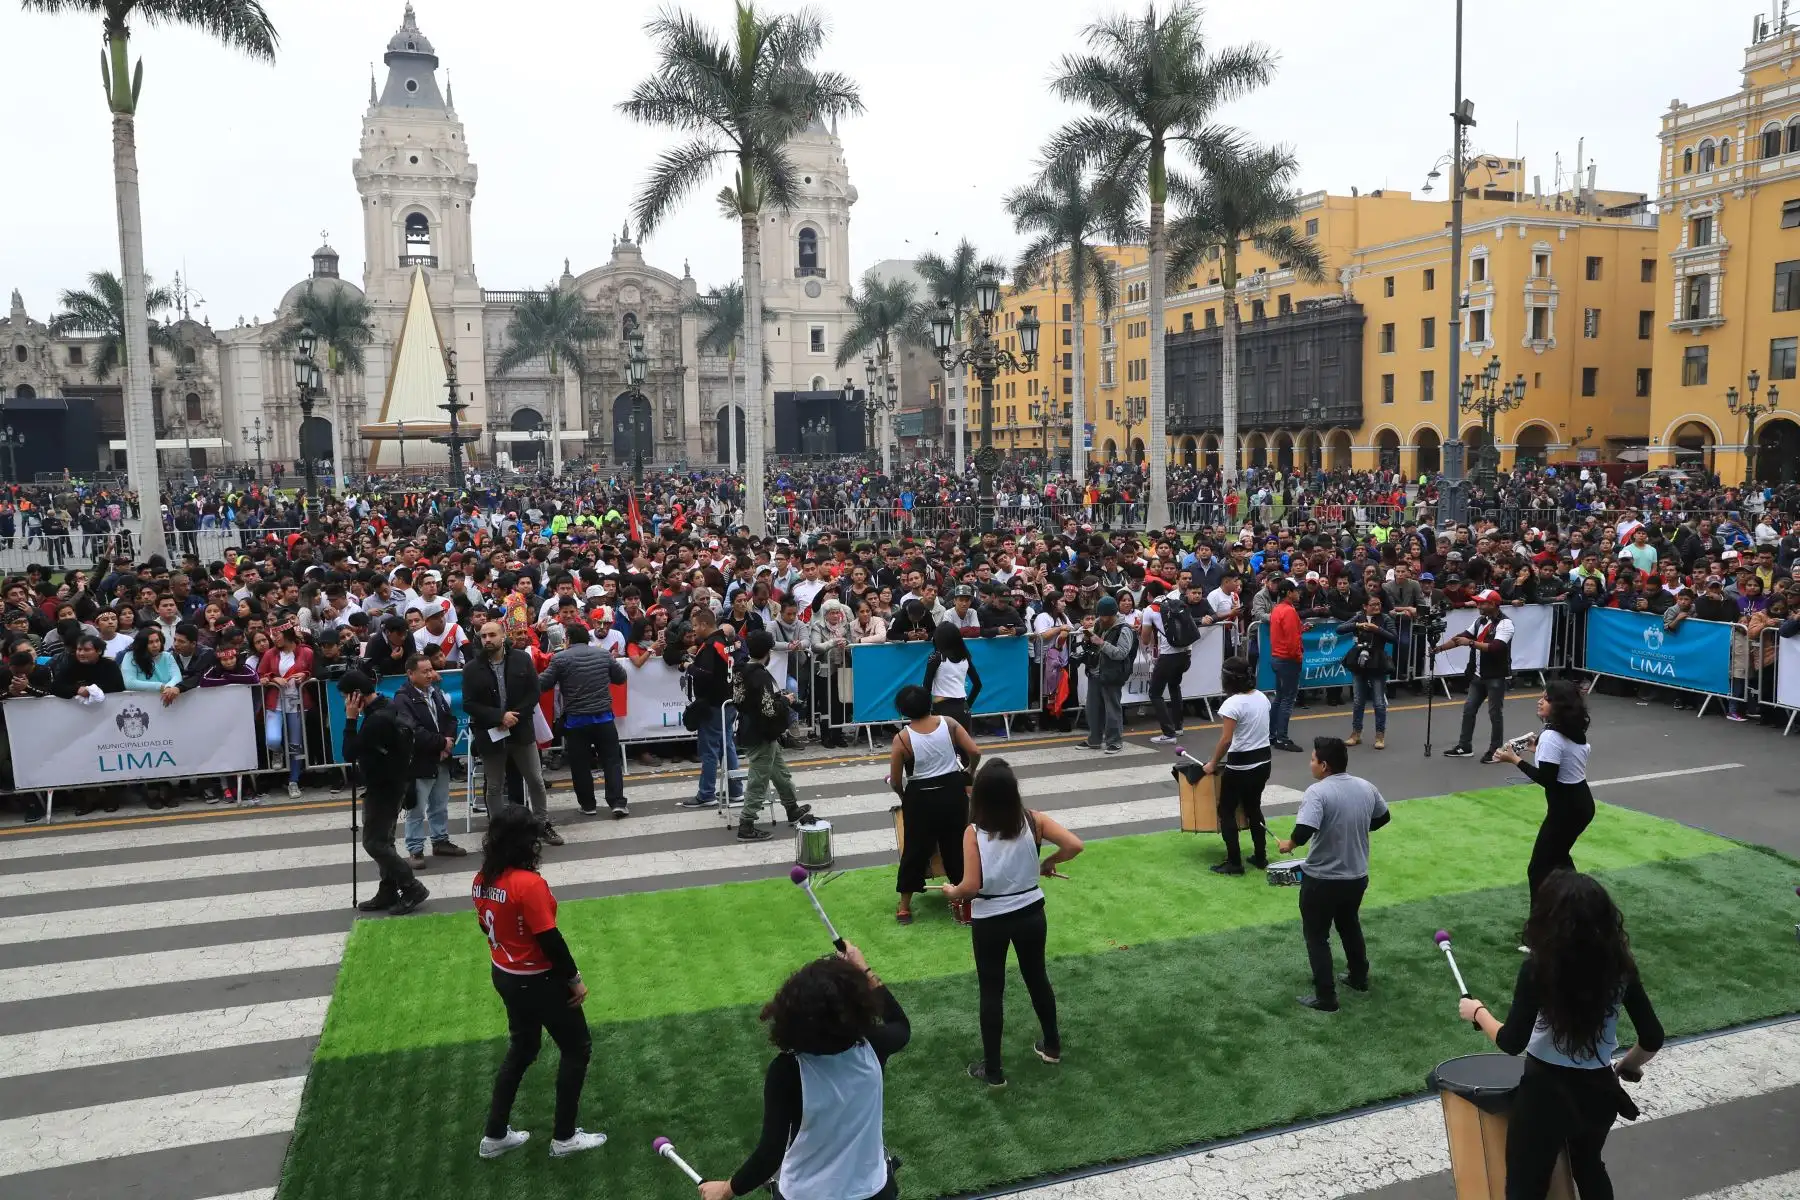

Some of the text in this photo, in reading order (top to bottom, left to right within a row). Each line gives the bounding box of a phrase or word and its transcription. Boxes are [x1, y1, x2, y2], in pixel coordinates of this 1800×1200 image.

[1305, 664, 1347, 680] LIMA
[1630, 656, 1676, 678] LIMA
[663, 711, 682, 728] LI
[97, 739, 161, 751] MUNICIPALIDAD
[98, 750, 177, 772] LIMA
